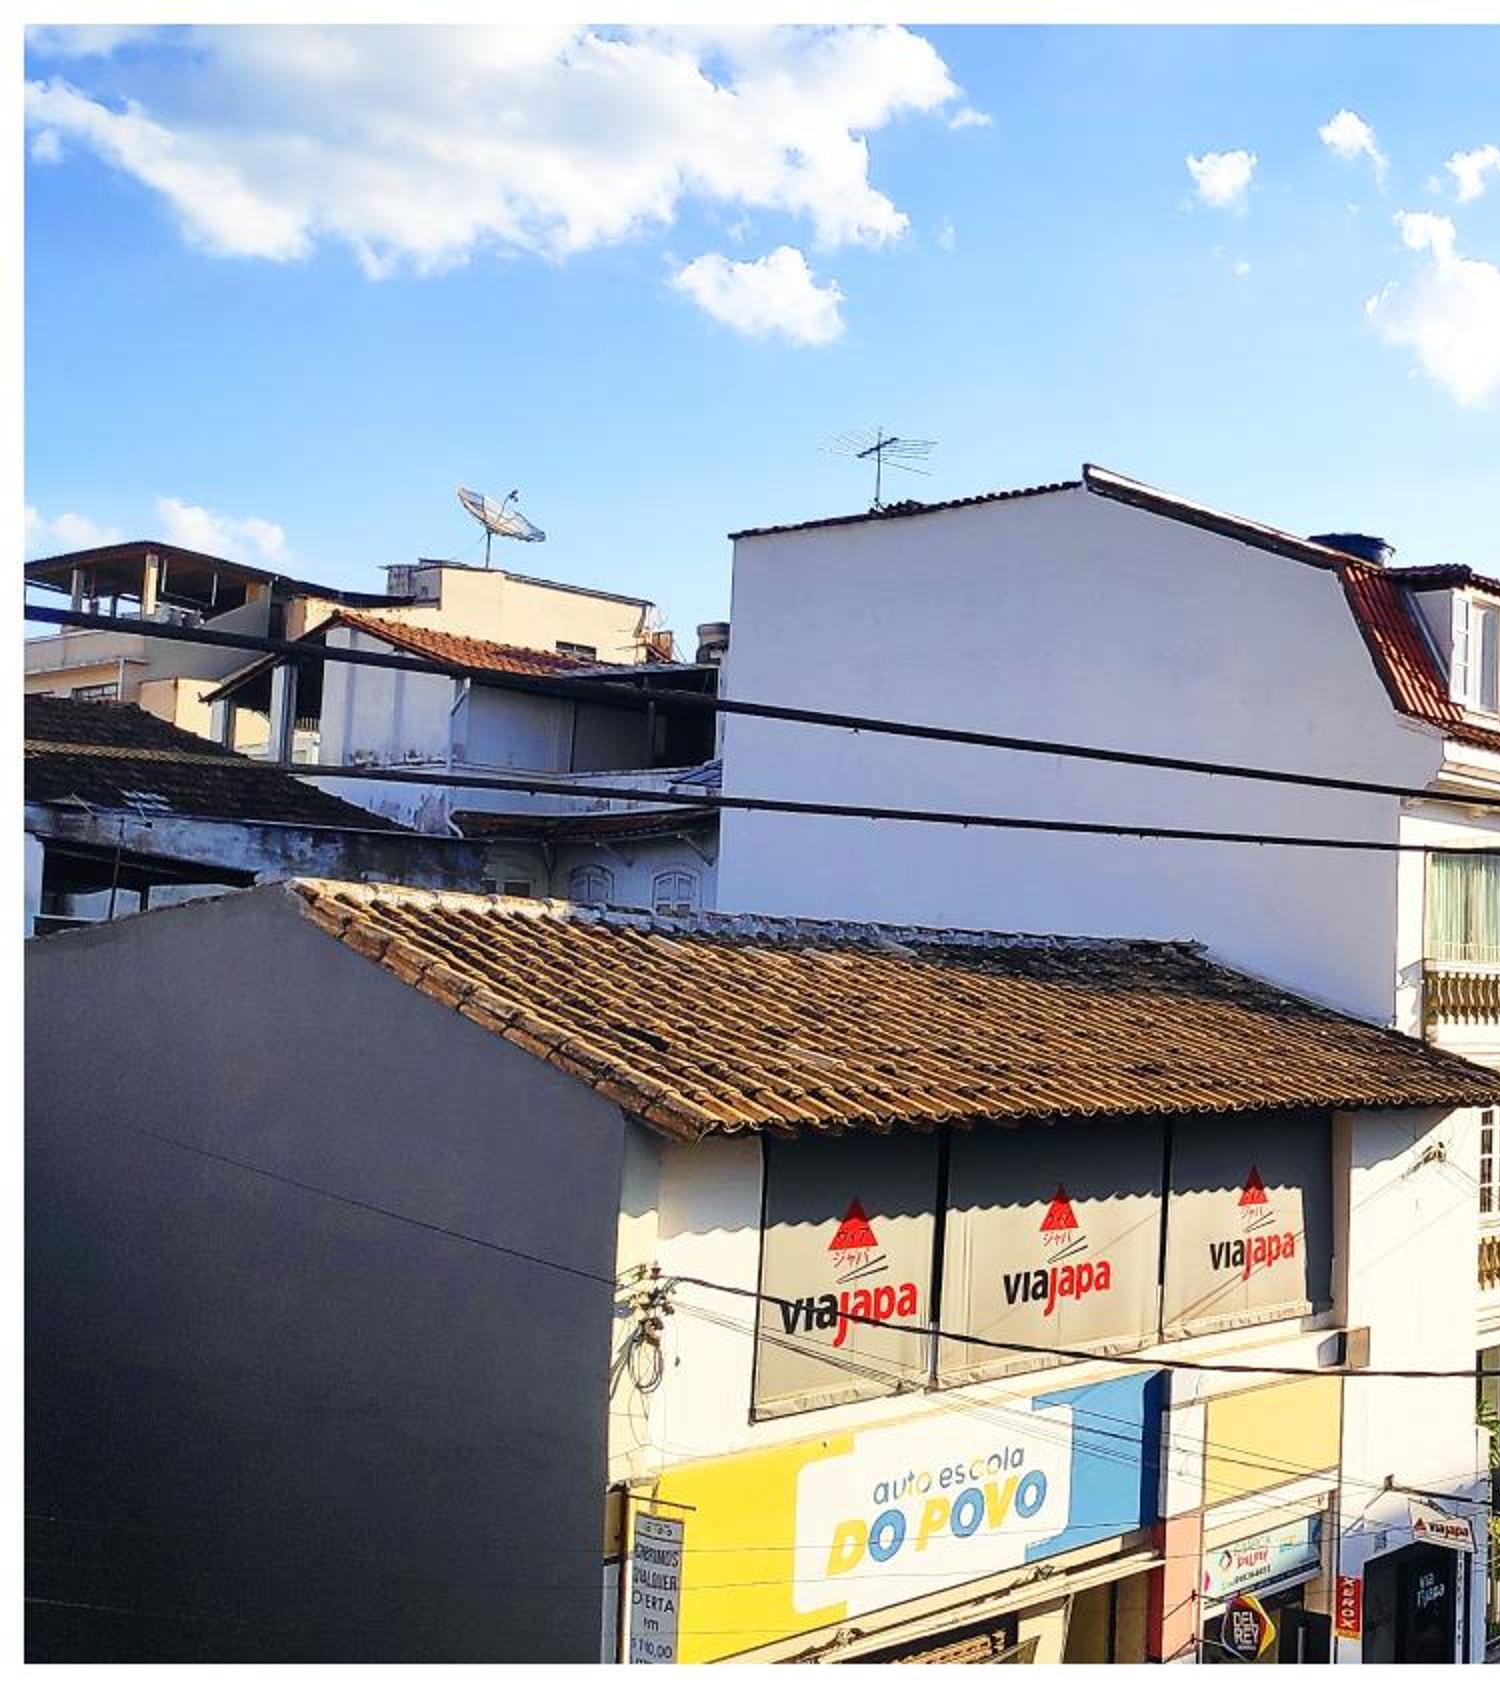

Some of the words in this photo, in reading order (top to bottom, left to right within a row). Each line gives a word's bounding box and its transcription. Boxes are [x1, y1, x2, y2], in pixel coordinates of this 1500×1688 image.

[873, 1471, 933, 1505] auto
[939, 1446, 1025, 1489] escola
[825, 1508, 907, 1577] DO
[915, 1469, 1048, 1553] POVO
[1233, 1611, 1253, 1627] DEL
[1340, 1577, 1356, 1631] XEROX
[1233, 1623, 1259, 1644] REY
